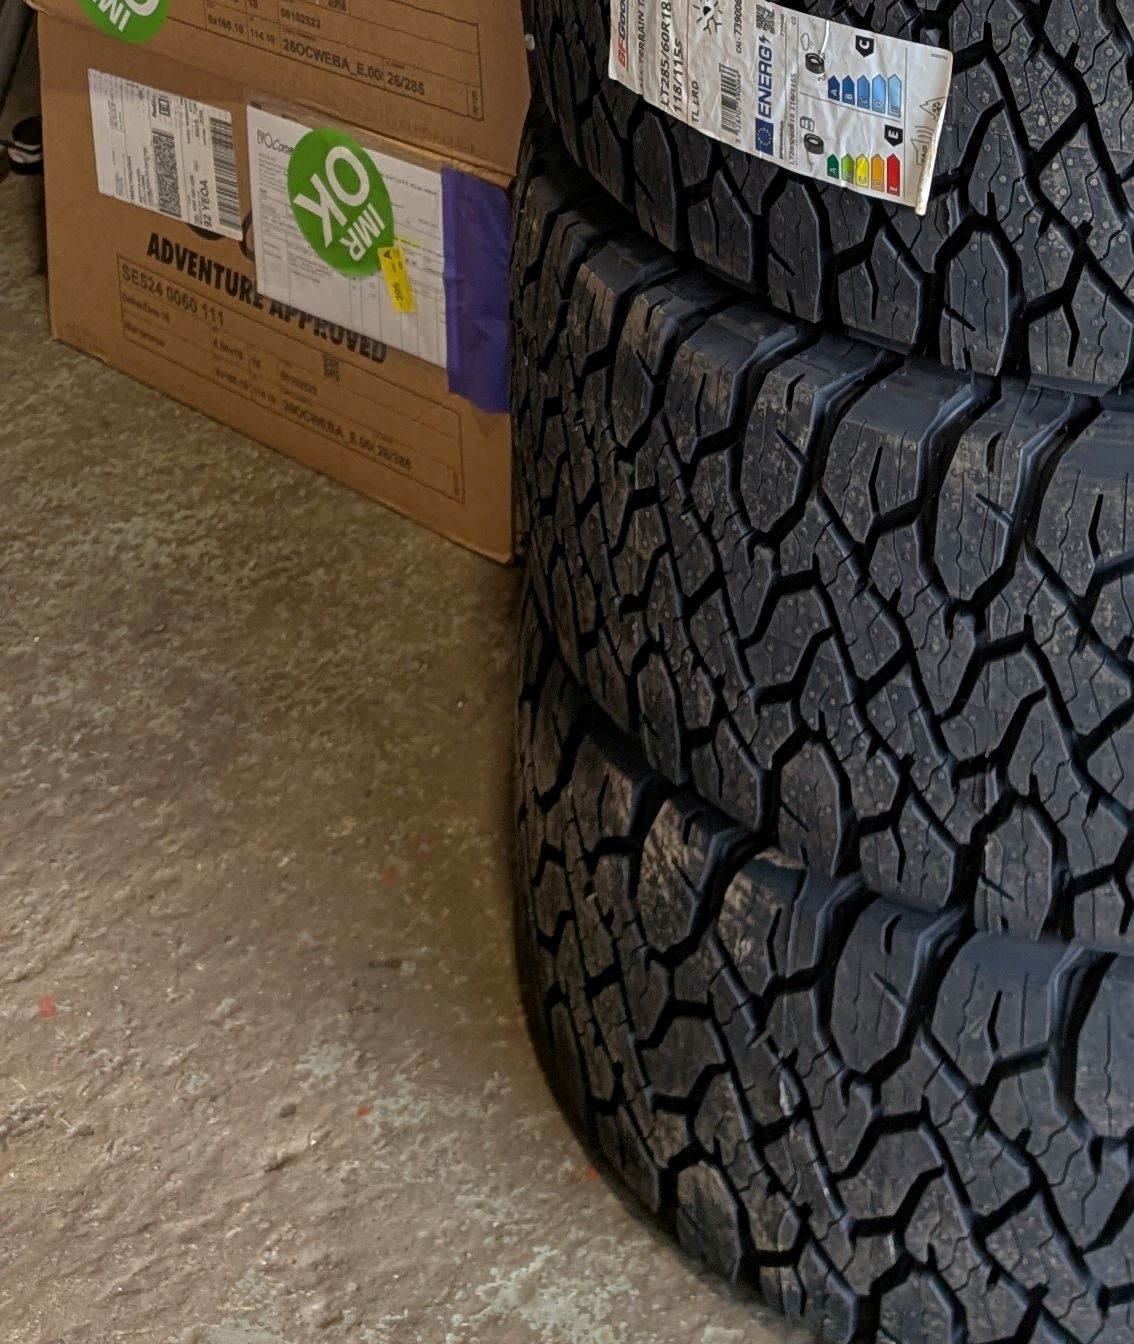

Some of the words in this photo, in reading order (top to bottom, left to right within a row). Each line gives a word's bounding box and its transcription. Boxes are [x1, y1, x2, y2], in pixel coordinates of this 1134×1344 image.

[660, 1, 671, 108] LT285/60R18
[672, 37, 684, 114] 118/115S
[858, 39, 869, 50] C
[758, 46, 772, 119] ENERG
[887, 130, 899, 139] E
[293, 146, 370, 248] OK
[339, 203, 385, 262] IMR
[122, 264, 163, 297] SE524
